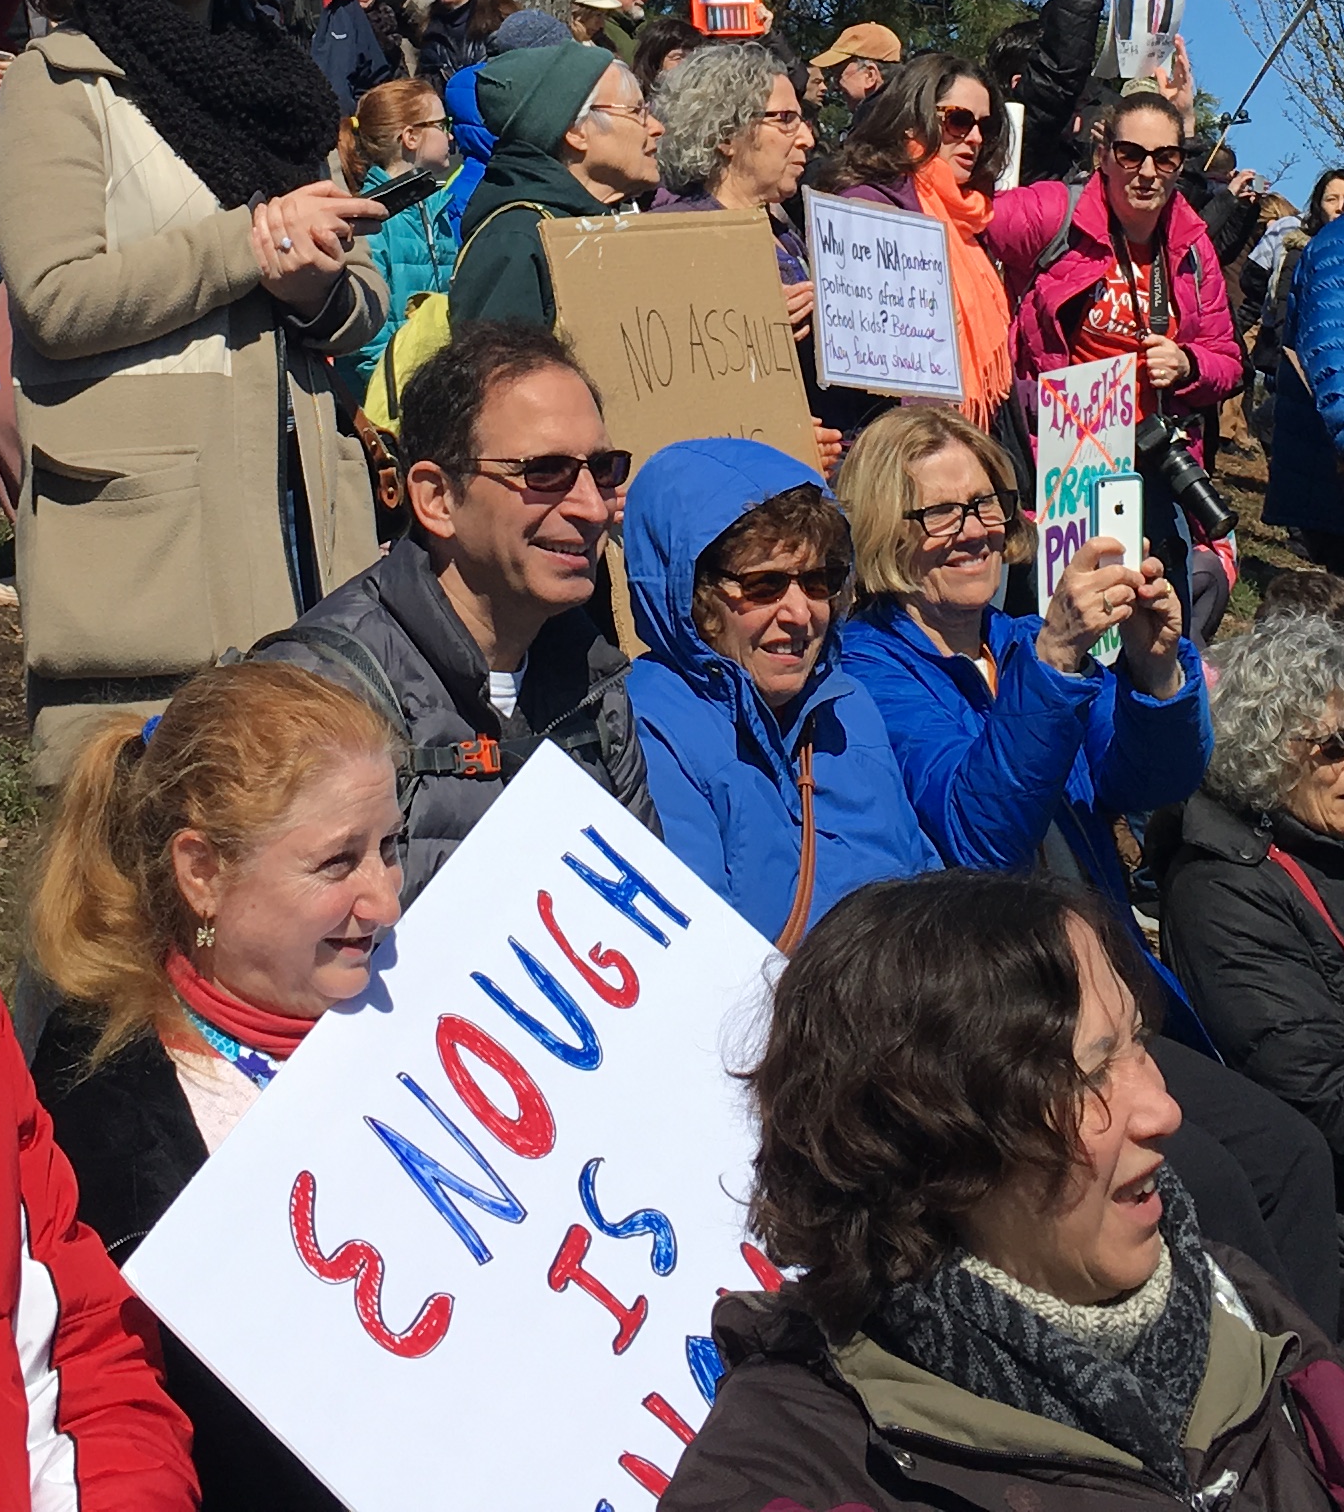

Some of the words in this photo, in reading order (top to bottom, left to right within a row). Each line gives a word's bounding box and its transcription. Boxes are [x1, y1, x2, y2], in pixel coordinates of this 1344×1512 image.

[816, 218, 846, 269] Why
[852, 242, 872, 262] are
[876, 238, 901, 272] NRA
[901, 251, 944, 285] pandering
[821, 274, 873, 301] politicians
[878, 281, 904, 308] afraid
[907, 287, 916, 309] of
[920, 290, 939, 317] High
[825, 304, 855, 330] School
[860, 310, 889, 334] kids?
[890, 314, 946, 343] Because
[620, 306, 673, 402] NO
[689, 303, 798, 381] ASSAULT
[891, 350, 926, 373] should
[289, 825, 692, 1359] ENOUGH
[548, 1157, 678, 1355] IS
